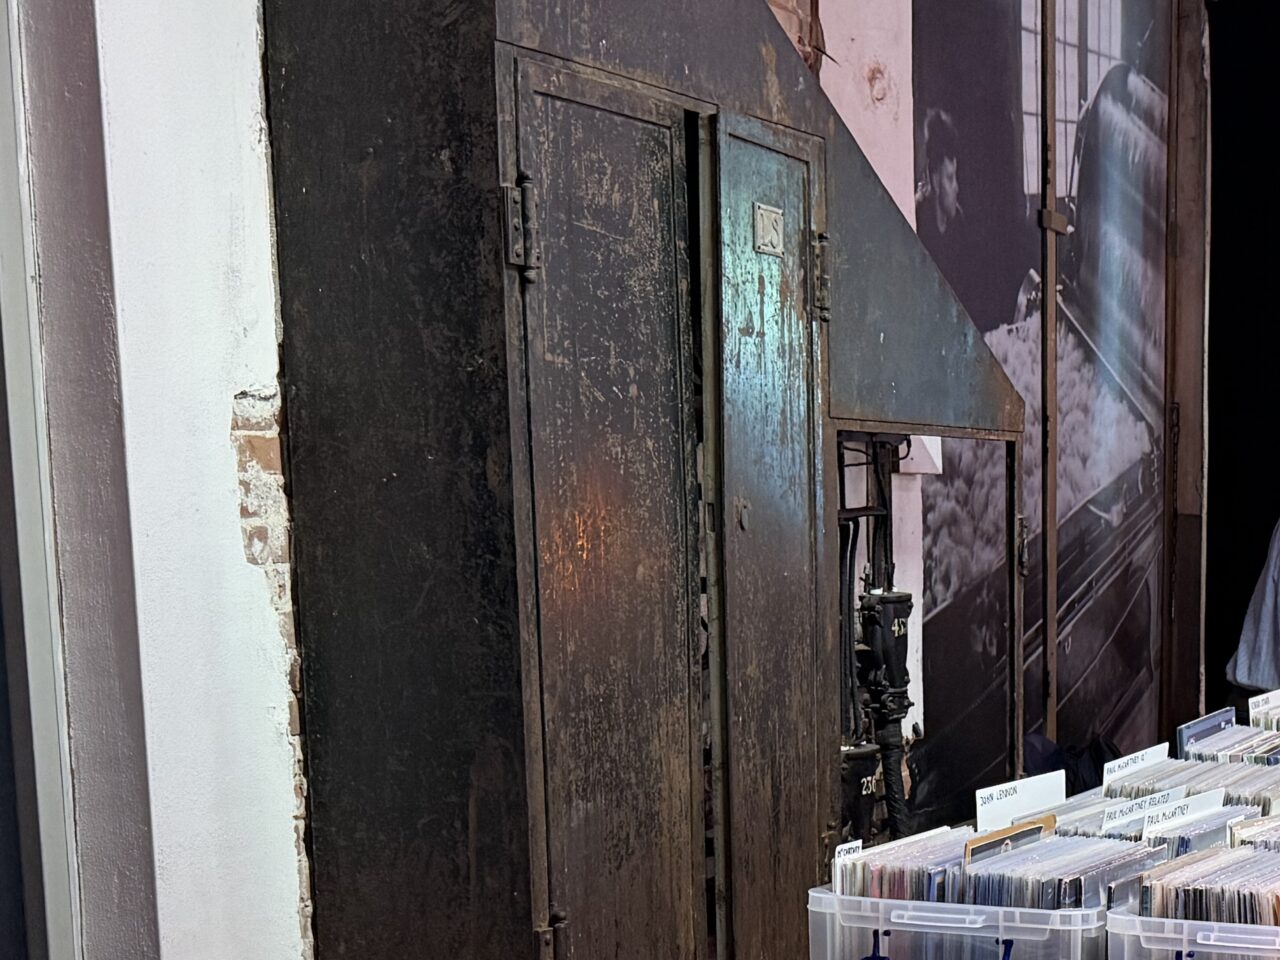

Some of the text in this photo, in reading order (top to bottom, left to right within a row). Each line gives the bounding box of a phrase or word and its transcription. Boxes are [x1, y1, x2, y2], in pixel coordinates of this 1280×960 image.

[1106, 766, 1117, 775] PAUL
[980, 785, 1018, 807] JOHN LENNON
[1106, 793, 1170, 821] PAUL McCARTNEY RELATED
[1147, 804, 1190, 826] PAUL McCARTNEY
